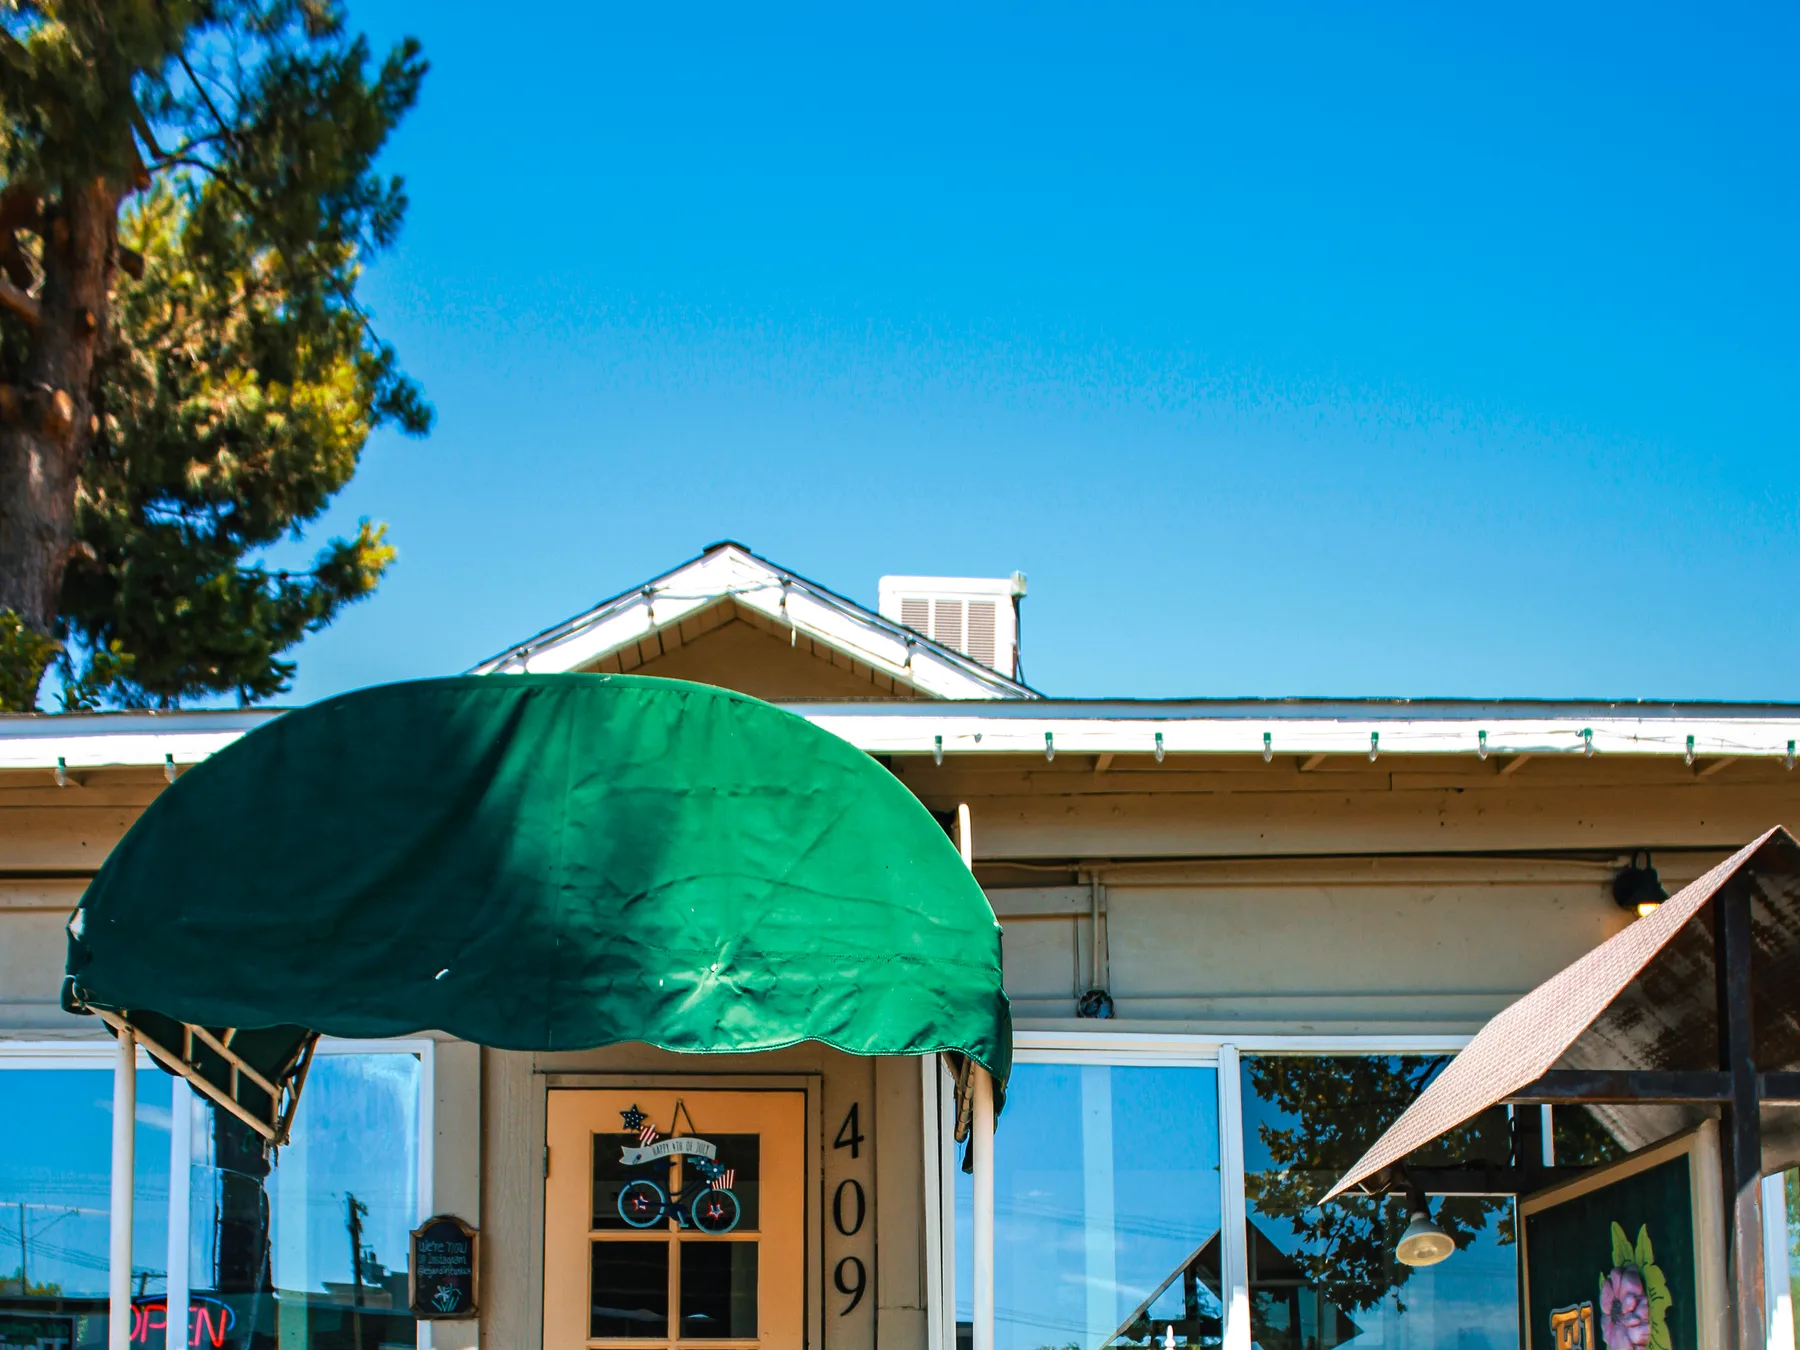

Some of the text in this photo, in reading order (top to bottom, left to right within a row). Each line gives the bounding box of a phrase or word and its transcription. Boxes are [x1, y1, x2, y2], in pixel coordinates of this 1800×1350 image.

[652, 1143, 669, 1156] HAPPY
[685, 1141, 693, 1153] OF
[696, 1142, 710, 1155] JULY
[833, 1102, 867, 1317] 409
